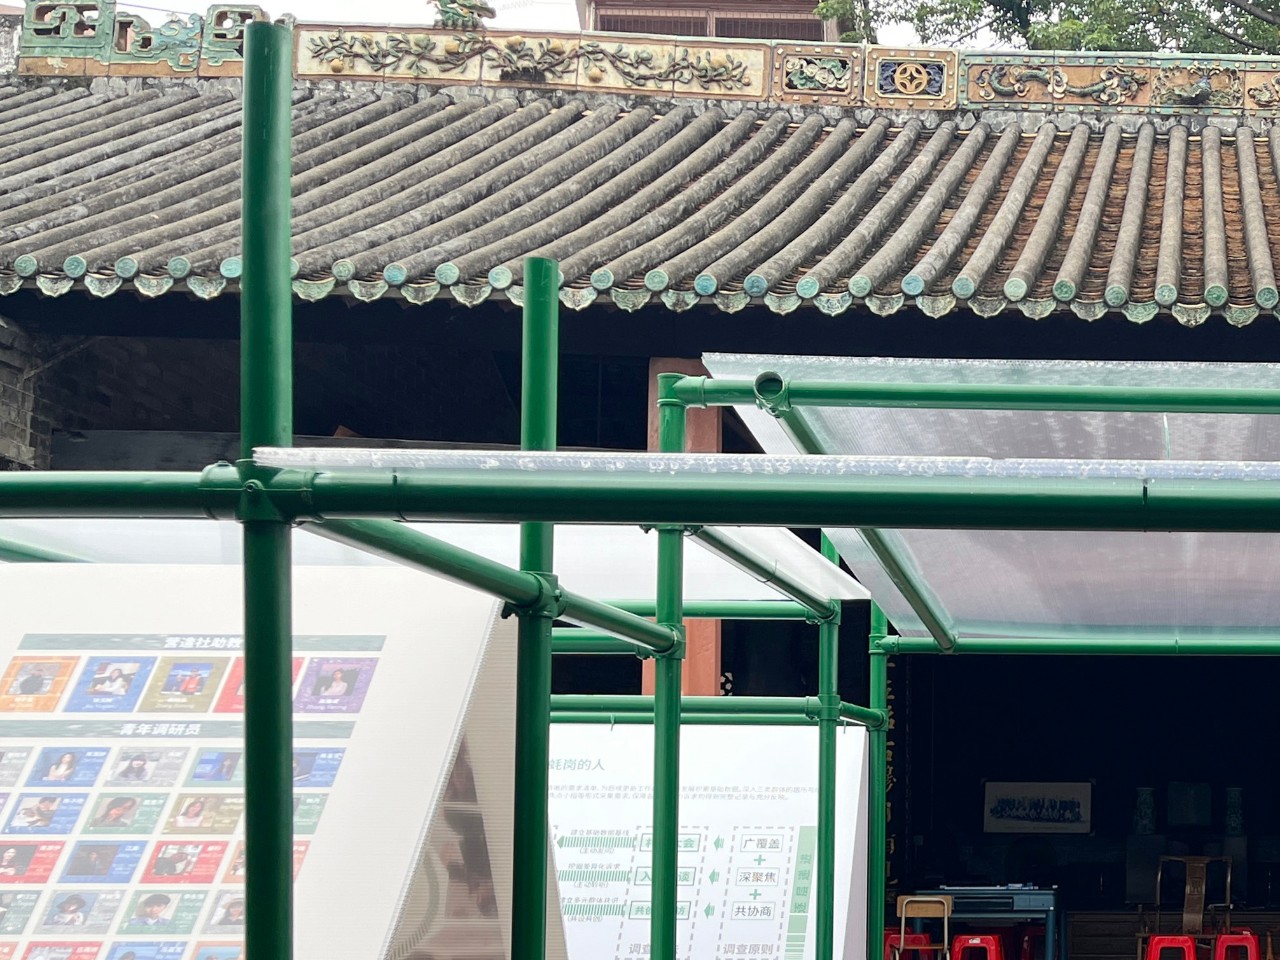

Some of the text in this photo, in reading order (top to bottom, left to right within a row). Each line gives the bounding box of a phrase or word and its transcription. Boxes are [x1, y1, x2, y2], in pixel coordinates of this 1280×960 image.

[119, 723, 201, 736] 青年调研员
[743, 838, 780, 850] 广覆盖
[739, 872, 776, 883] 深聚焦
[734, 905, 773, 917] 共协商
[723, 943, 774, 955] 调查原则
